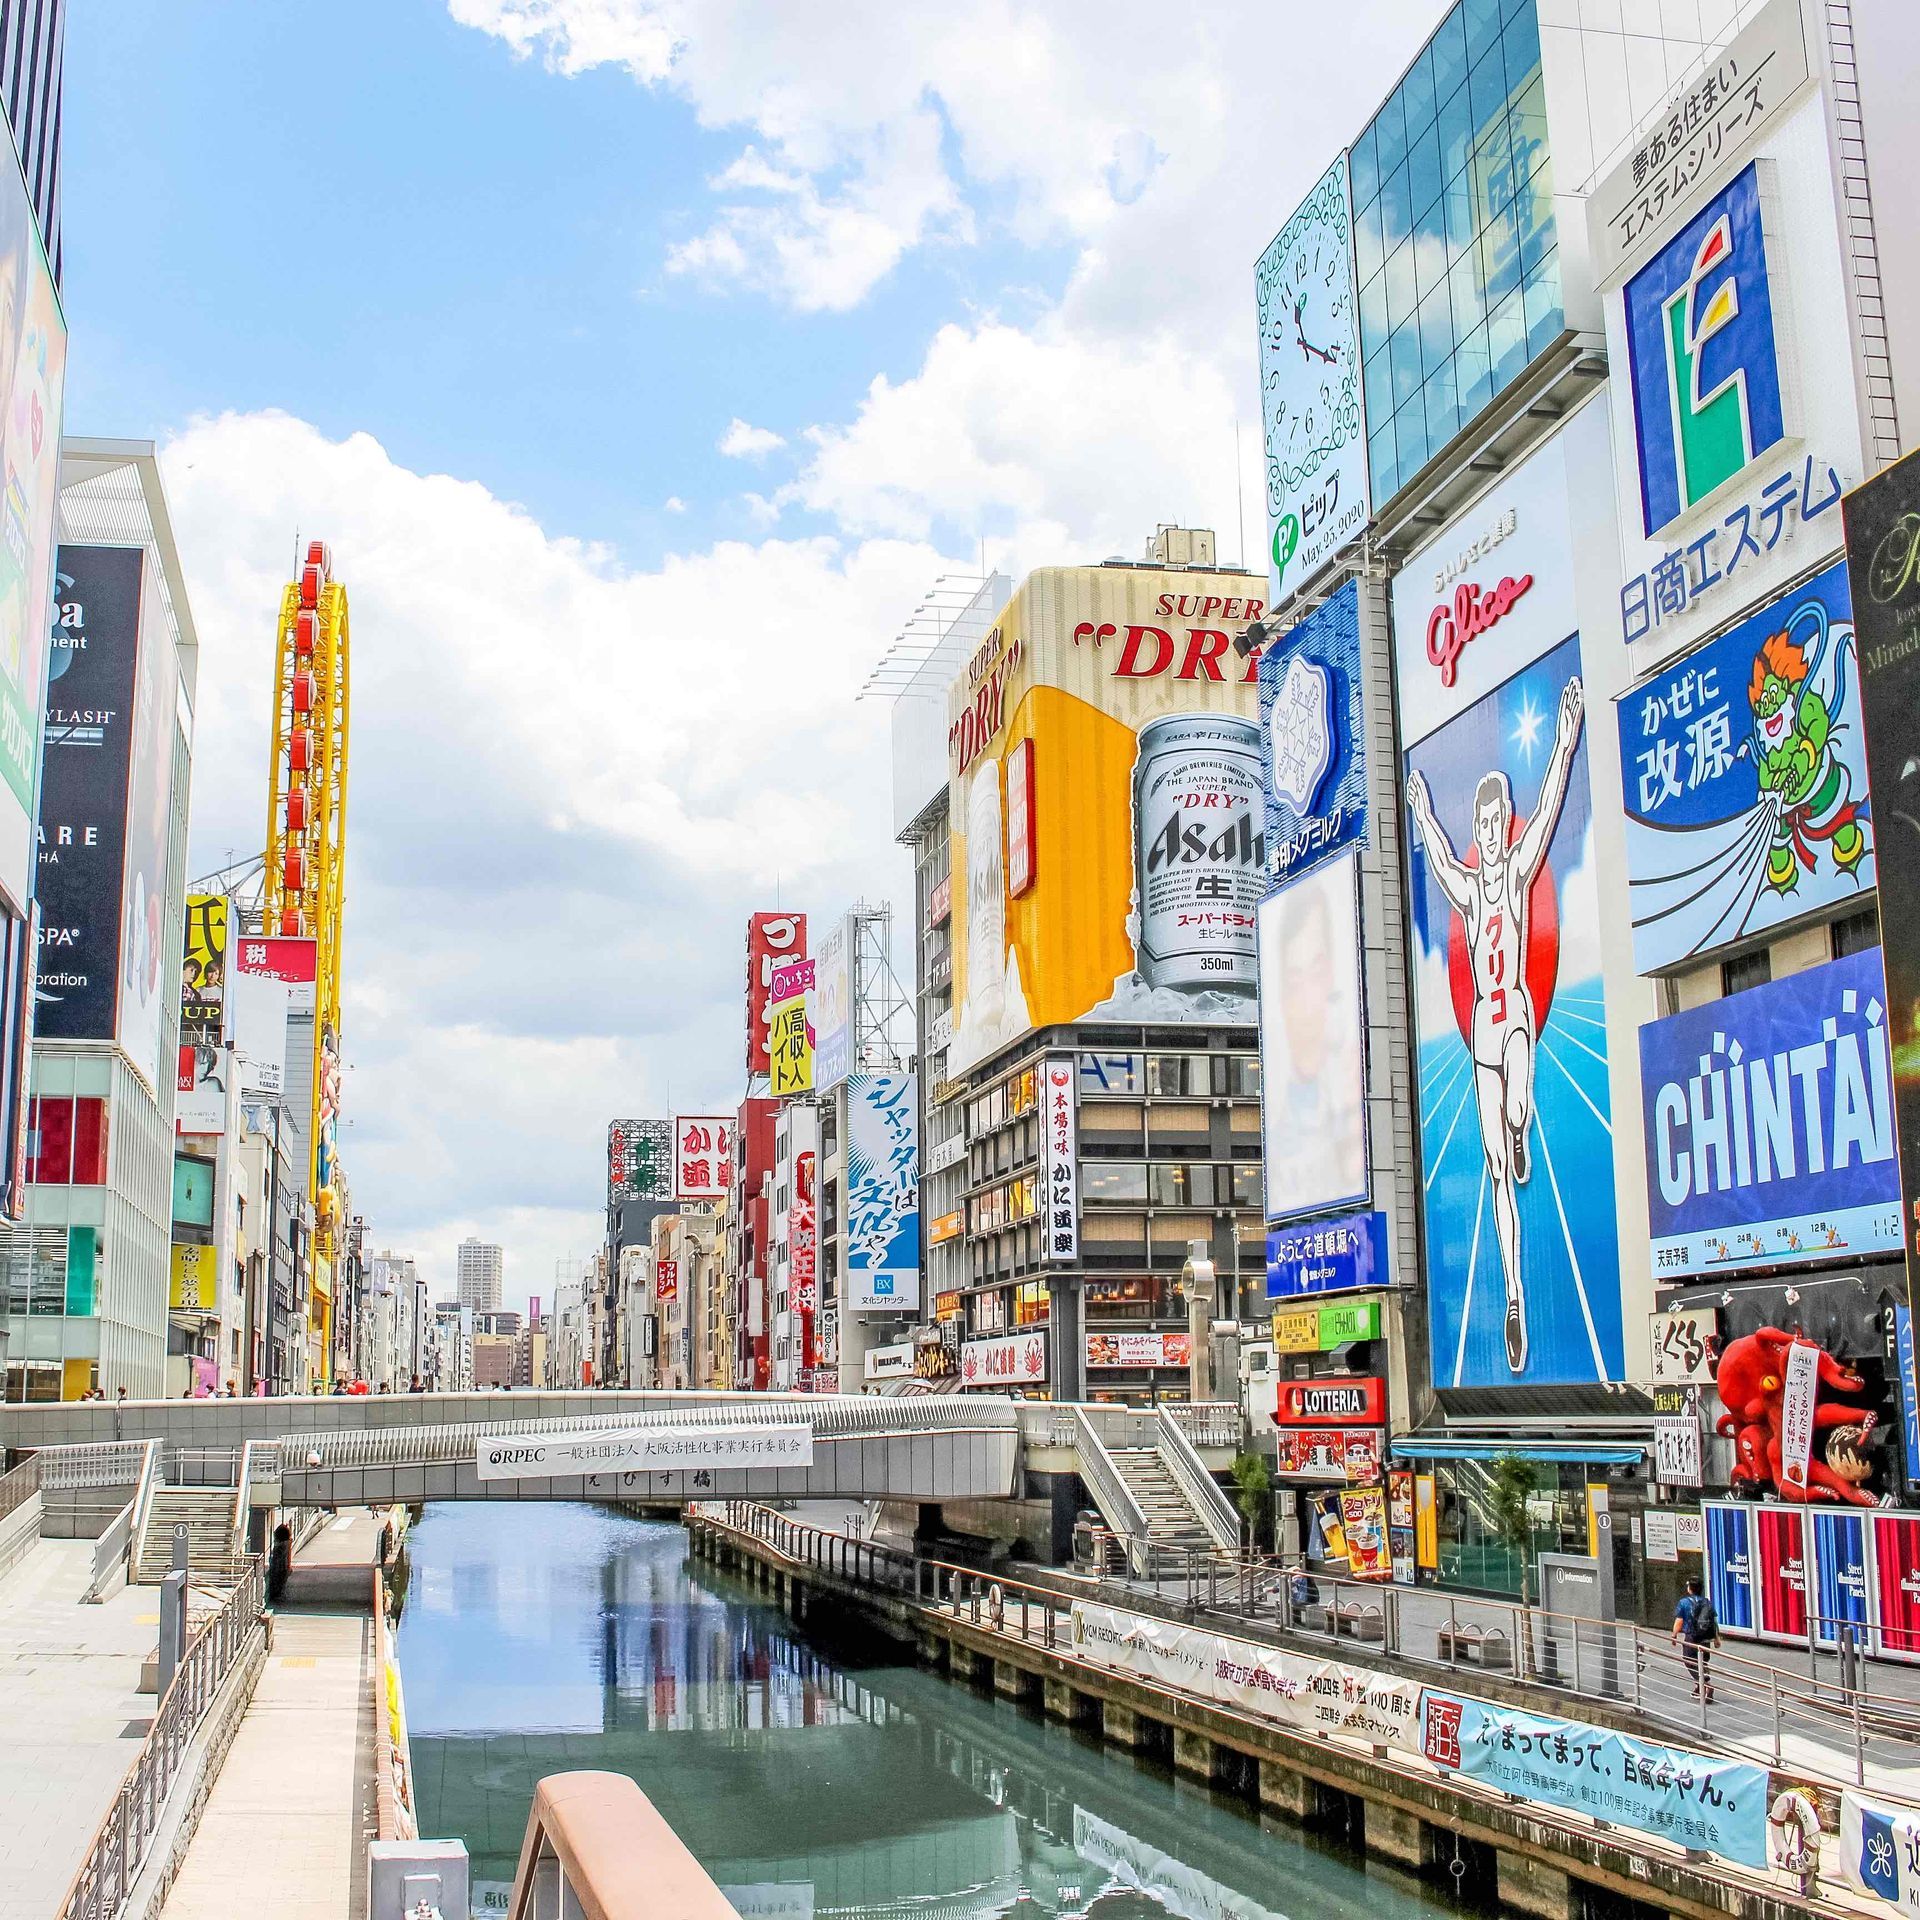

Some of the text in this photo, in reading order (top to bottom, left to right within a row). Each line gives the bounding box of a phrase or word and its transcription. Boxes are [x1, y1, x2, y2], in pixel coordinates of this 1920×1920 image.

[1631, 60, 1738, 189] 夢ある住まい
[1621, 77, 1764, 250] エステムシリーズ
[1295, 253, 1307, 285] 12
[1324, 261, 1336, 288] 2
[1280, 282, 1293, 310] 11
[1271, 320, 1283, 351] 10
[1276, 400, 1287, 425] 8
[1305, 407, 1313, 435] 6
[1290, 416, 1300, 441] 7
[1302, 469, 1340, 538] ピップ
[1339, 500, 1365, 536] 2020
[1620, 454, 1843, 645] 日商エステム
[1155, 593, 1265, 621] SUPER
[1427, 574, 1533, 688] Glico
[968, 626, 1002, 691] SUPER
[1641, 667, 1720, 737] かぜに
[1165, 731, 1251, 746] KARA 辛口 KUCHI
[1636, 702, 1734, 813] 改源
[1166, 778, 1183, 787] THE
[1222, 777, 1254, 789] BRAND
[1173, 765, 1189, 778] ASAHI
[1223, 765, 1247, 779] LIMITED
[1269, 808, 1342, 876] 雪印メグミルク
[1195, 875, 1234, 900] 生
[1178, 913, 1255, 928] スーパードライ
[246, 944, 267, 965] 税
[1200, 957, 1234, 971] 350ml
[1485, 906, 1508, 1025] グリコ
[774, 1010, 790, 1091] バイト
[1656, 990, 1894, 1207] CHINTAI
[1052, 1092, 1073, 1253] 本場の味 かに道楽
[1277, 1228, 1359, 1264] ようこそ道頓堀へ
[1657, 1247, 1689, 1268] 天気予報
[667, 1262, 676, 1287] ツルハ
[877, 1279, 891, 1290] BX
[861, 1296, 909, 1305] 文化シャッター
[1305, 1389, 1361, 1412] LOTTERIA
[557, 1443, 639, 1459] 一般社団法人
[644, 1436, 801, 1456] 大阪活性化事業実行委員会
[588, 1470, 712, 1488] えびす橋
[1343, 1495, 1382, 1511] タコドリ
